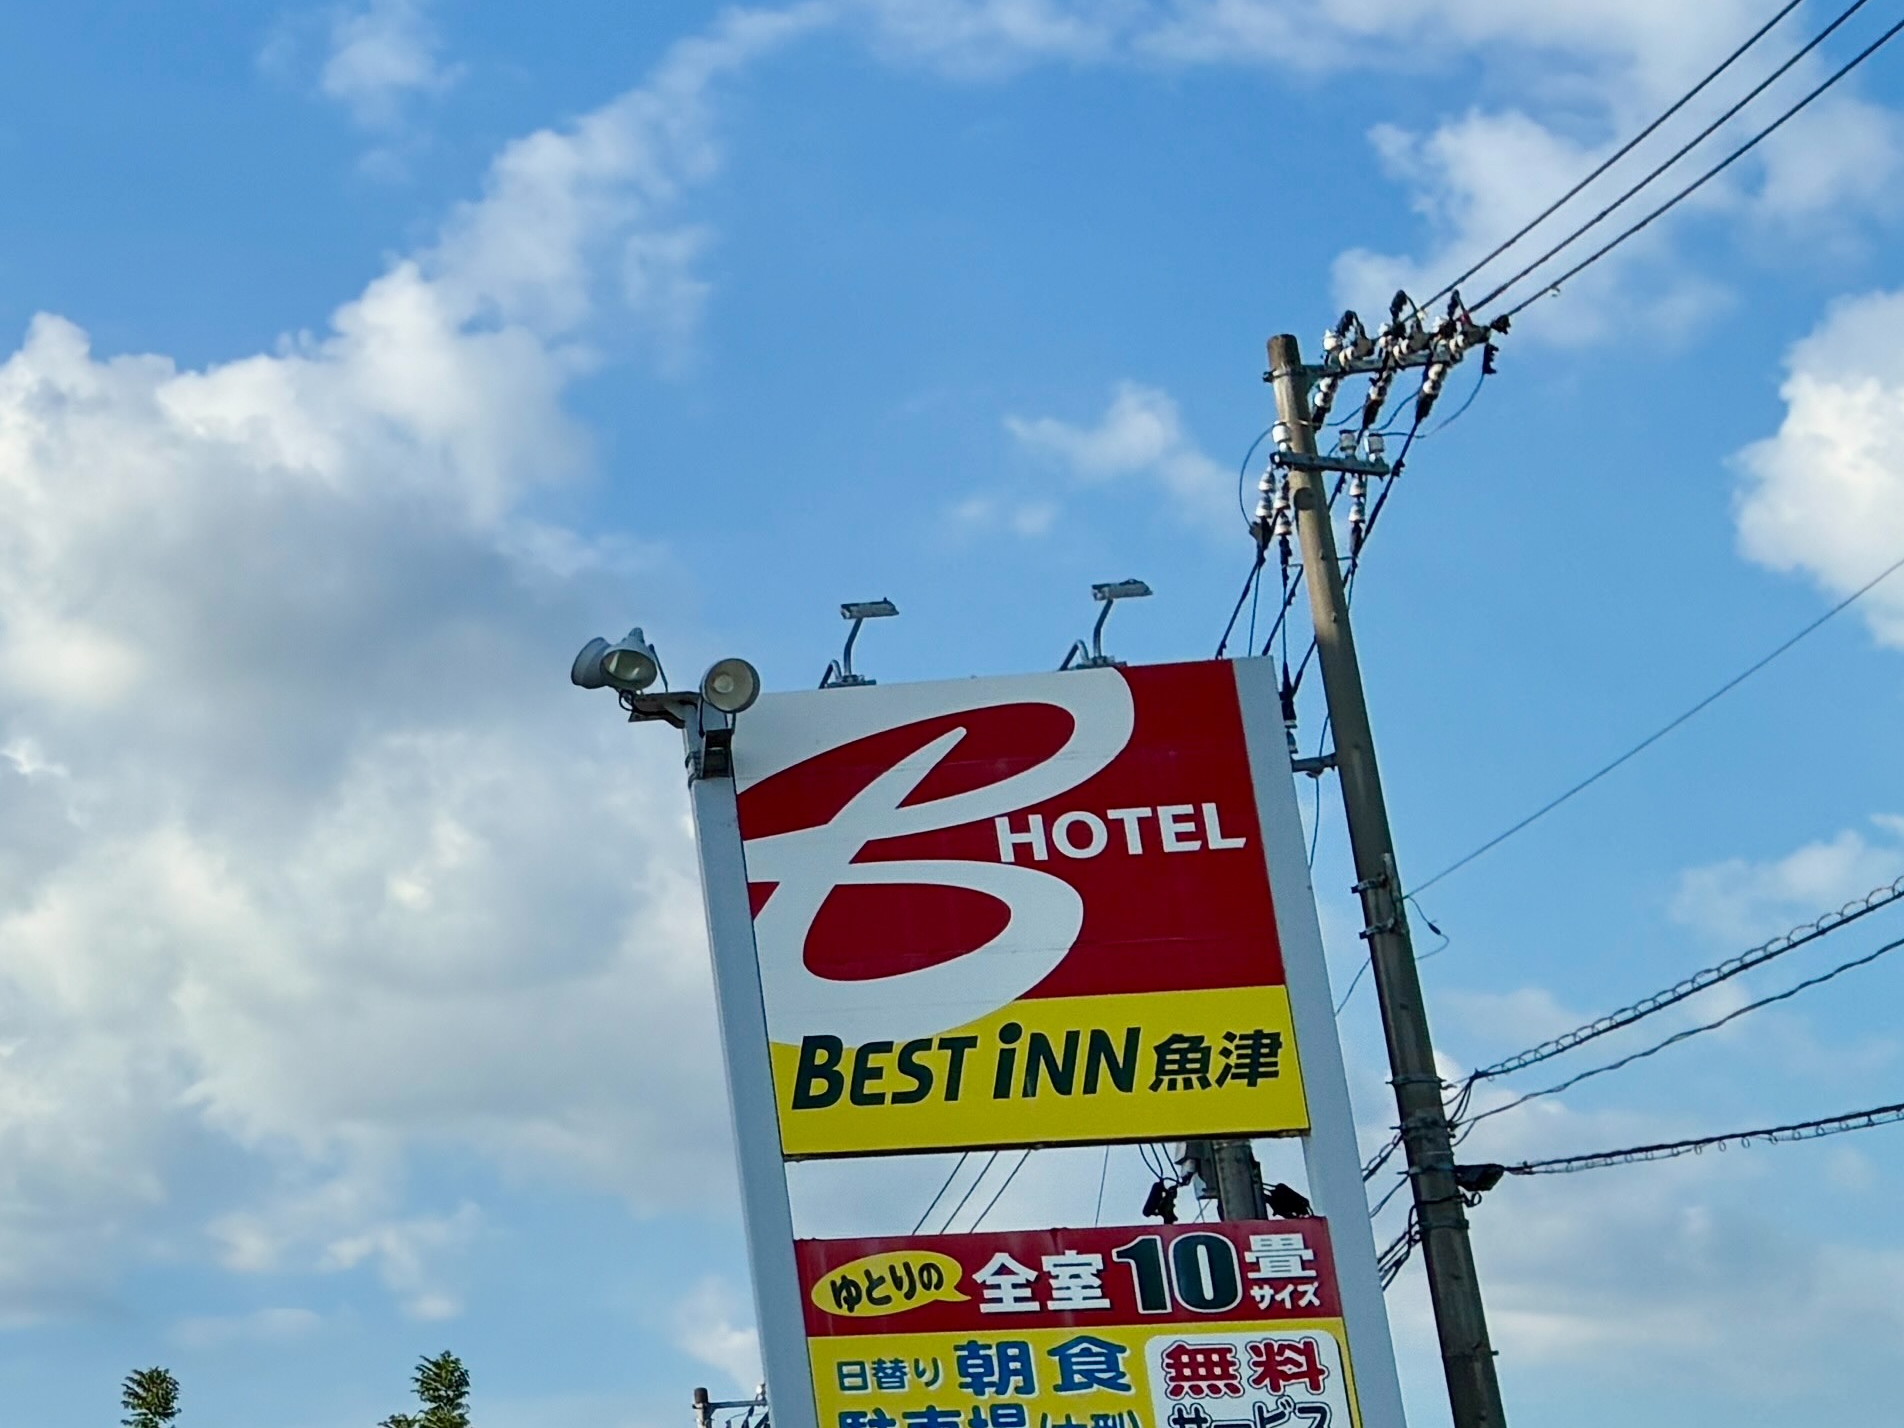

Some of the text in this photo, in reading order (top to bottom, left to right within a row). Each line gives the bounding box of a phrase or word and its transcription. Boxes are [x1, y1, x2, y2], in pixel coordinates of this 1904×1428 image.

[996, 803, 1246, 862] HOTEL
[792, 1035, 977, 1110] BEST
[1148, 1030, 1282, 1092] 魚津
[830, 1261, 943, 1312] ゆとりの
[1250, 1283, 1320, 1309] サイズ
[1162, 1337, 1329, 1399] 無料
